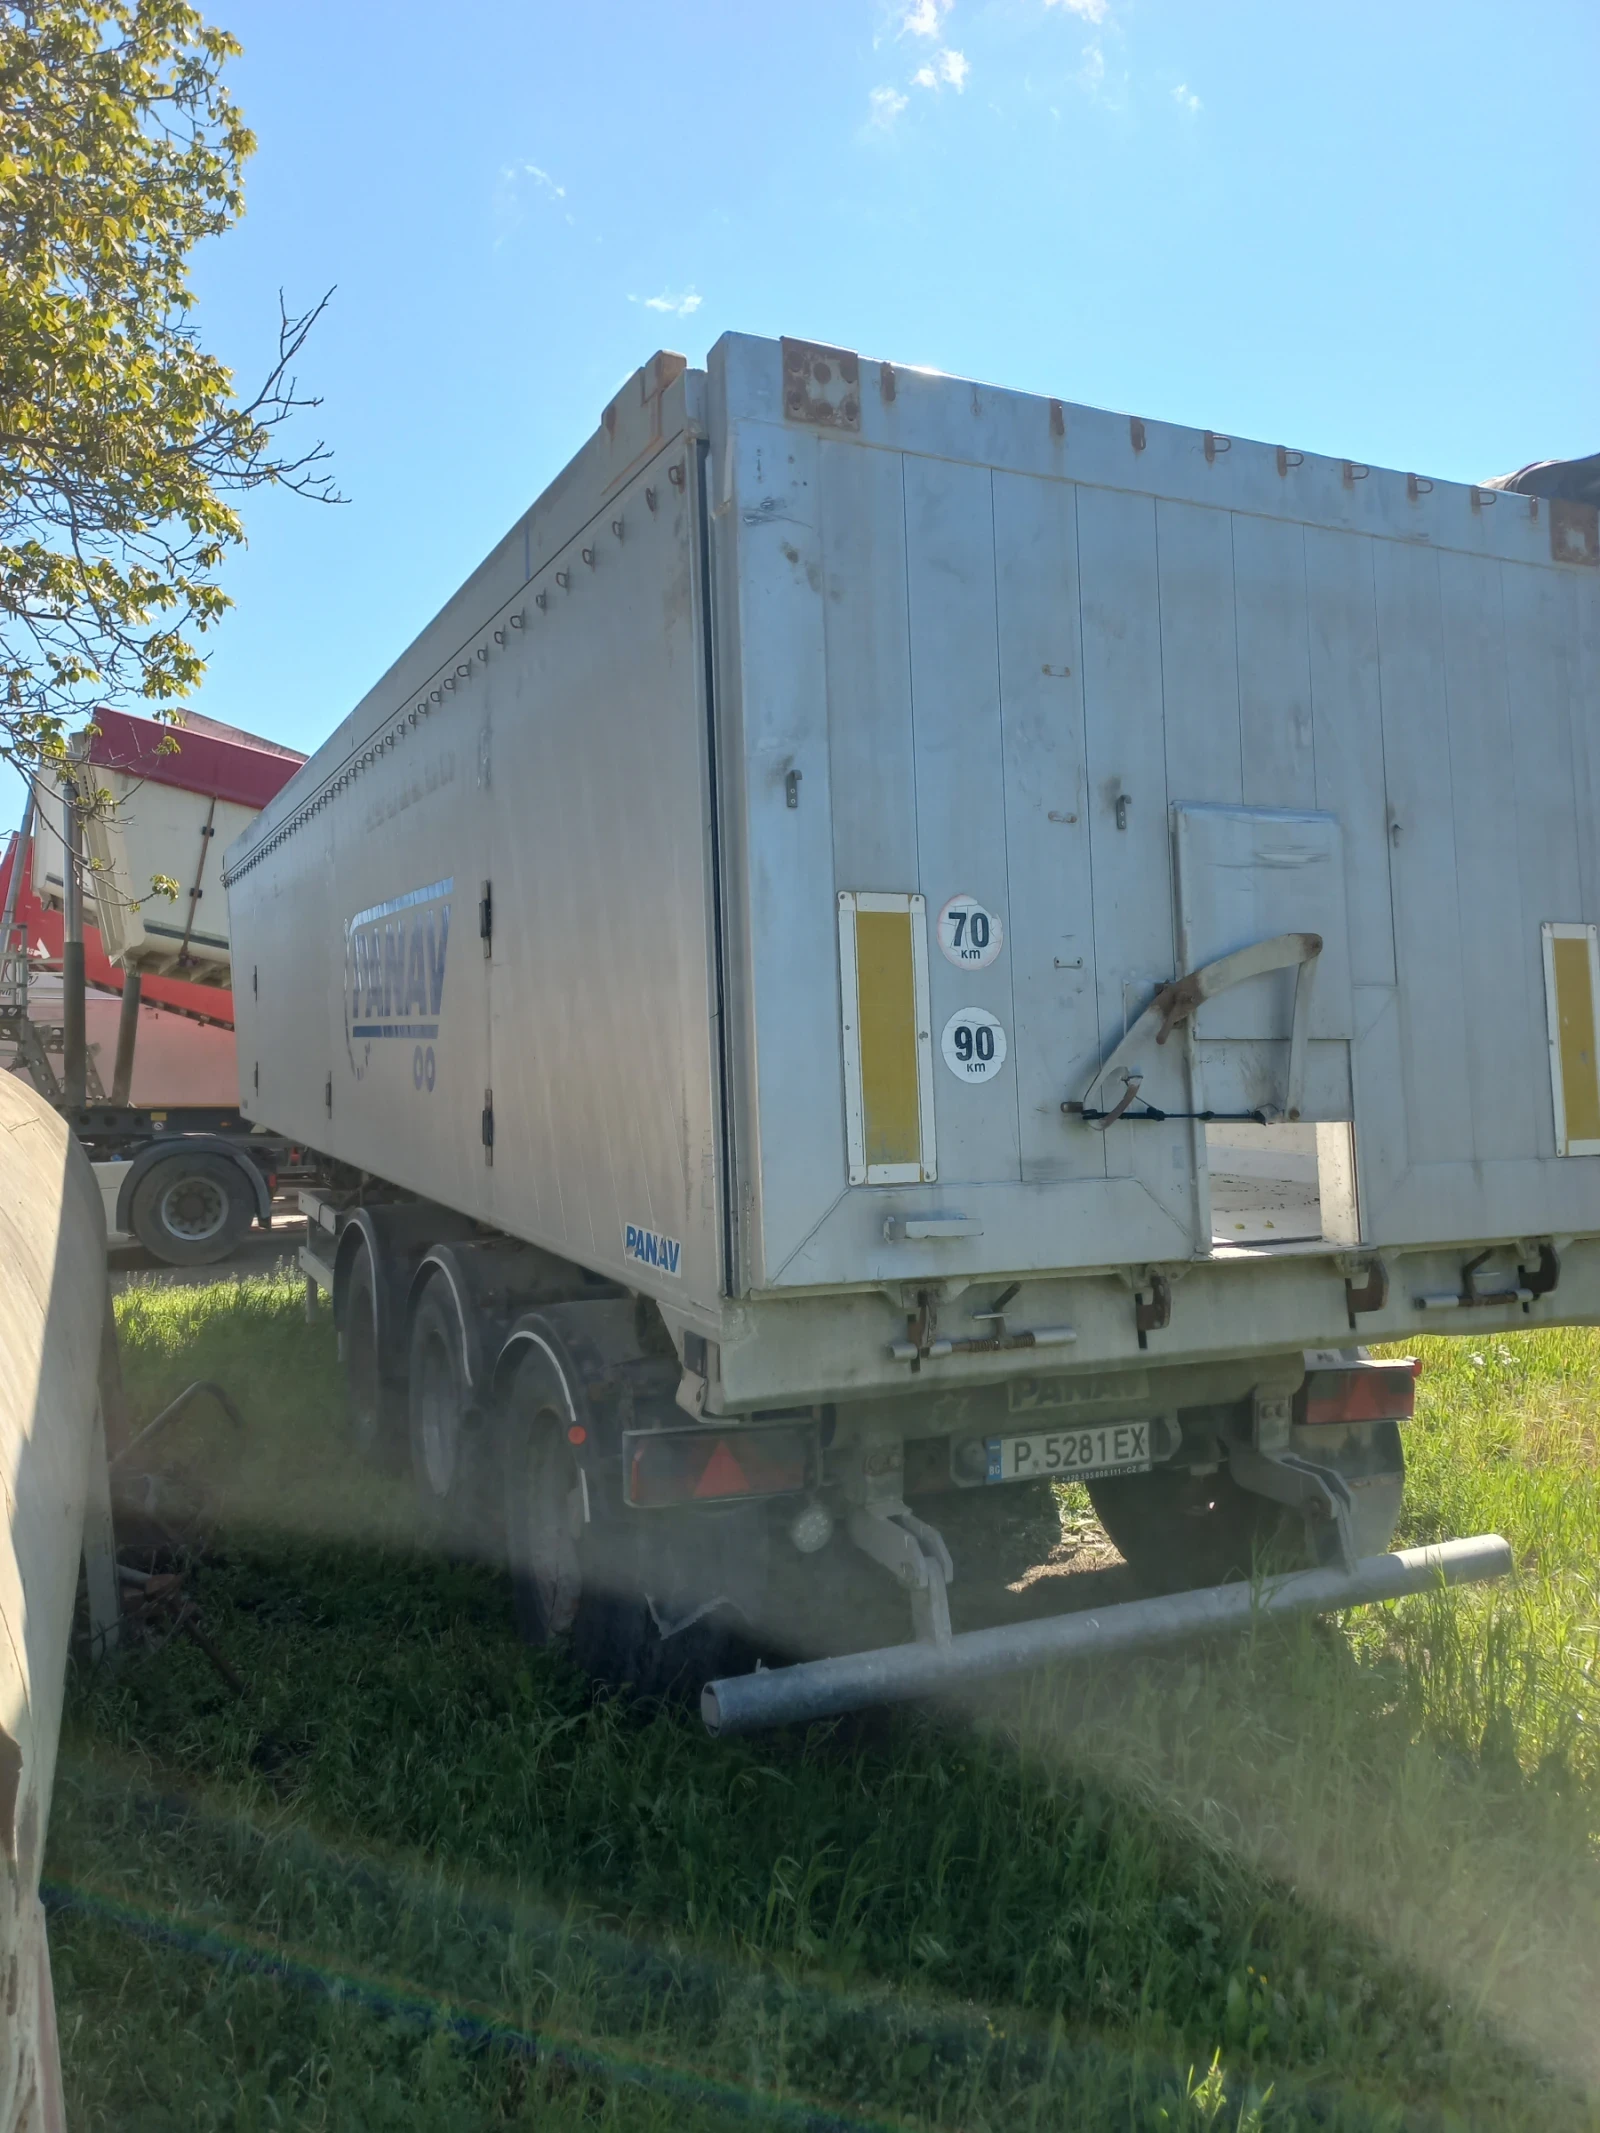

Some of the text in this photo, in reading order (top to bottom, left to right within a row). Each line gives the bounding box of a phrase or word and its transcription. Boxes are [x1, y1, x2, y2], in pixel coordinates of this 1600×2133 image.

[948, 911, 990, 948] 70
[353, 903, 451, 1018] PANAV
[954, 1026, 994, 1061] 90
[626, 1225, 680, 1273] PANAV
[988, 1464, 1001, 1475] BG
